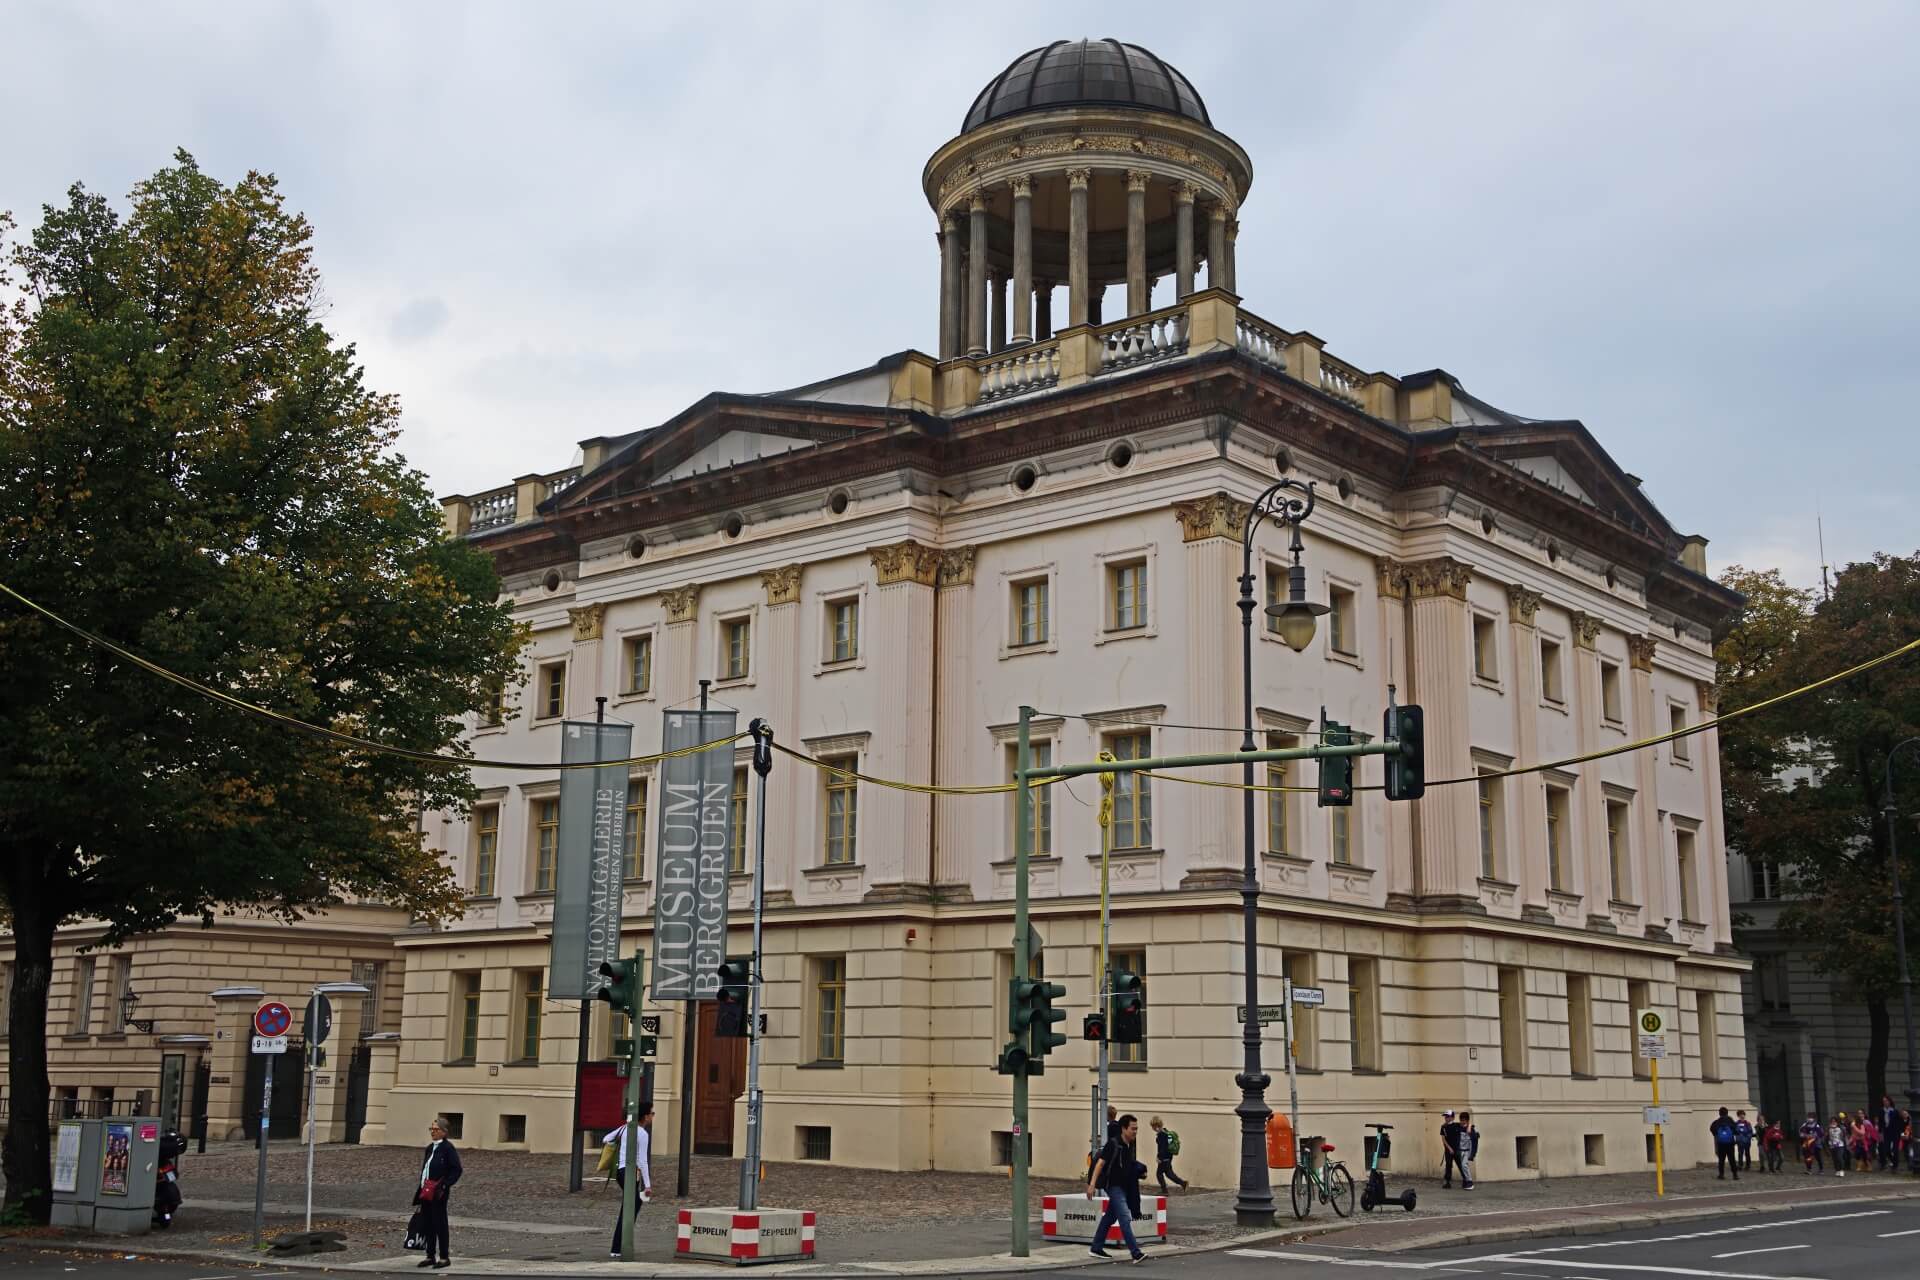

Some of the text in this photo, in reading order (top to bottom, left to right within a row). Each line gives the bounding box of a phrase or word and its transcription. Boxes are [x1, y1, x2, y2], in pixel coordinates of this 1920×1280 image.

[614, 790, 624, 837] BERLIN
[613, 840, 621, 856] ZU
[587, 790, 613, 993] NATIONALGALERIE
[609, 860, 621, 911] MUSEEN
[656, 780, 700, 996] MUSEUM
[695, 781, 728, 995] BERGGRUEN
[1646, 1016, 1656, 1028] H
[693, 1226, 728, 1237] ZEPPELIN
[761, 1227, 798, 1237] ZEPPELIN
[1064, 1213, 1096, 1221] ZEPPELIN
